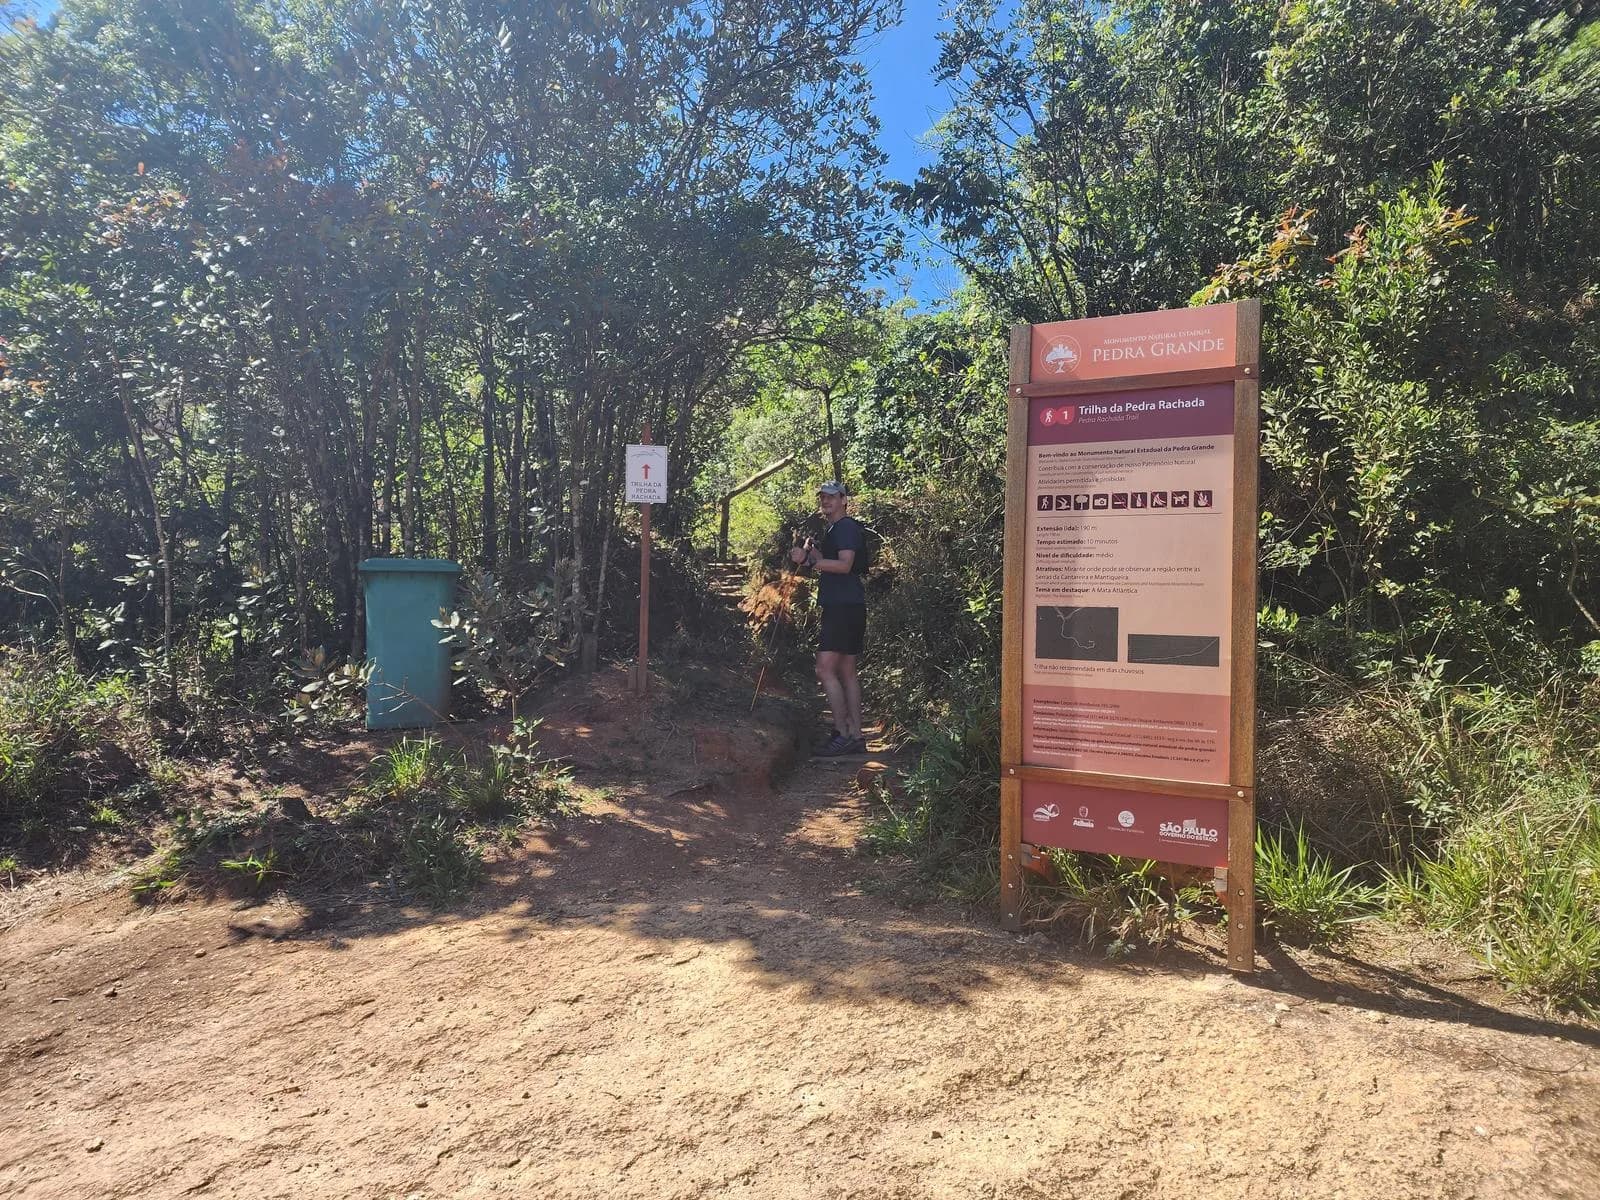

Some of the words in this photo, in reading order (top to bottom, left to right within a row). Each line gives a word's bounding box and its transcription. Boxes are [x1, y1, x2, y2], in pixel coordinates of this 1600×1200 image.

[1093, 346, 1145, 362] PEDRA
[1151, 338, 1224, 356] GRANDE
[1078, 403, 1108, 415] Trilha
[1109, 403, 1123, 414] da
[1125, 400, 1156, 412] Pedra
[1158, 397, 1205, 410] Rachada
[1062, 410, 1068, 420] 1
[1078, 416, 1096, 424] Pedra
[1125, 413, 1139, 421] Trail
[1191, 443, 1215, 451] Grande
[1081, 462, 1115, 470] conservação
[1065, 476, 1095, 485] permitidas
[1159, 821, 1182, 834] SÃO
[1182, 826, 1218, 838] PAULO
[1159, 831, 1186, 839] GOVERNO
[1195, 835, 1218, 843] ESTADO
